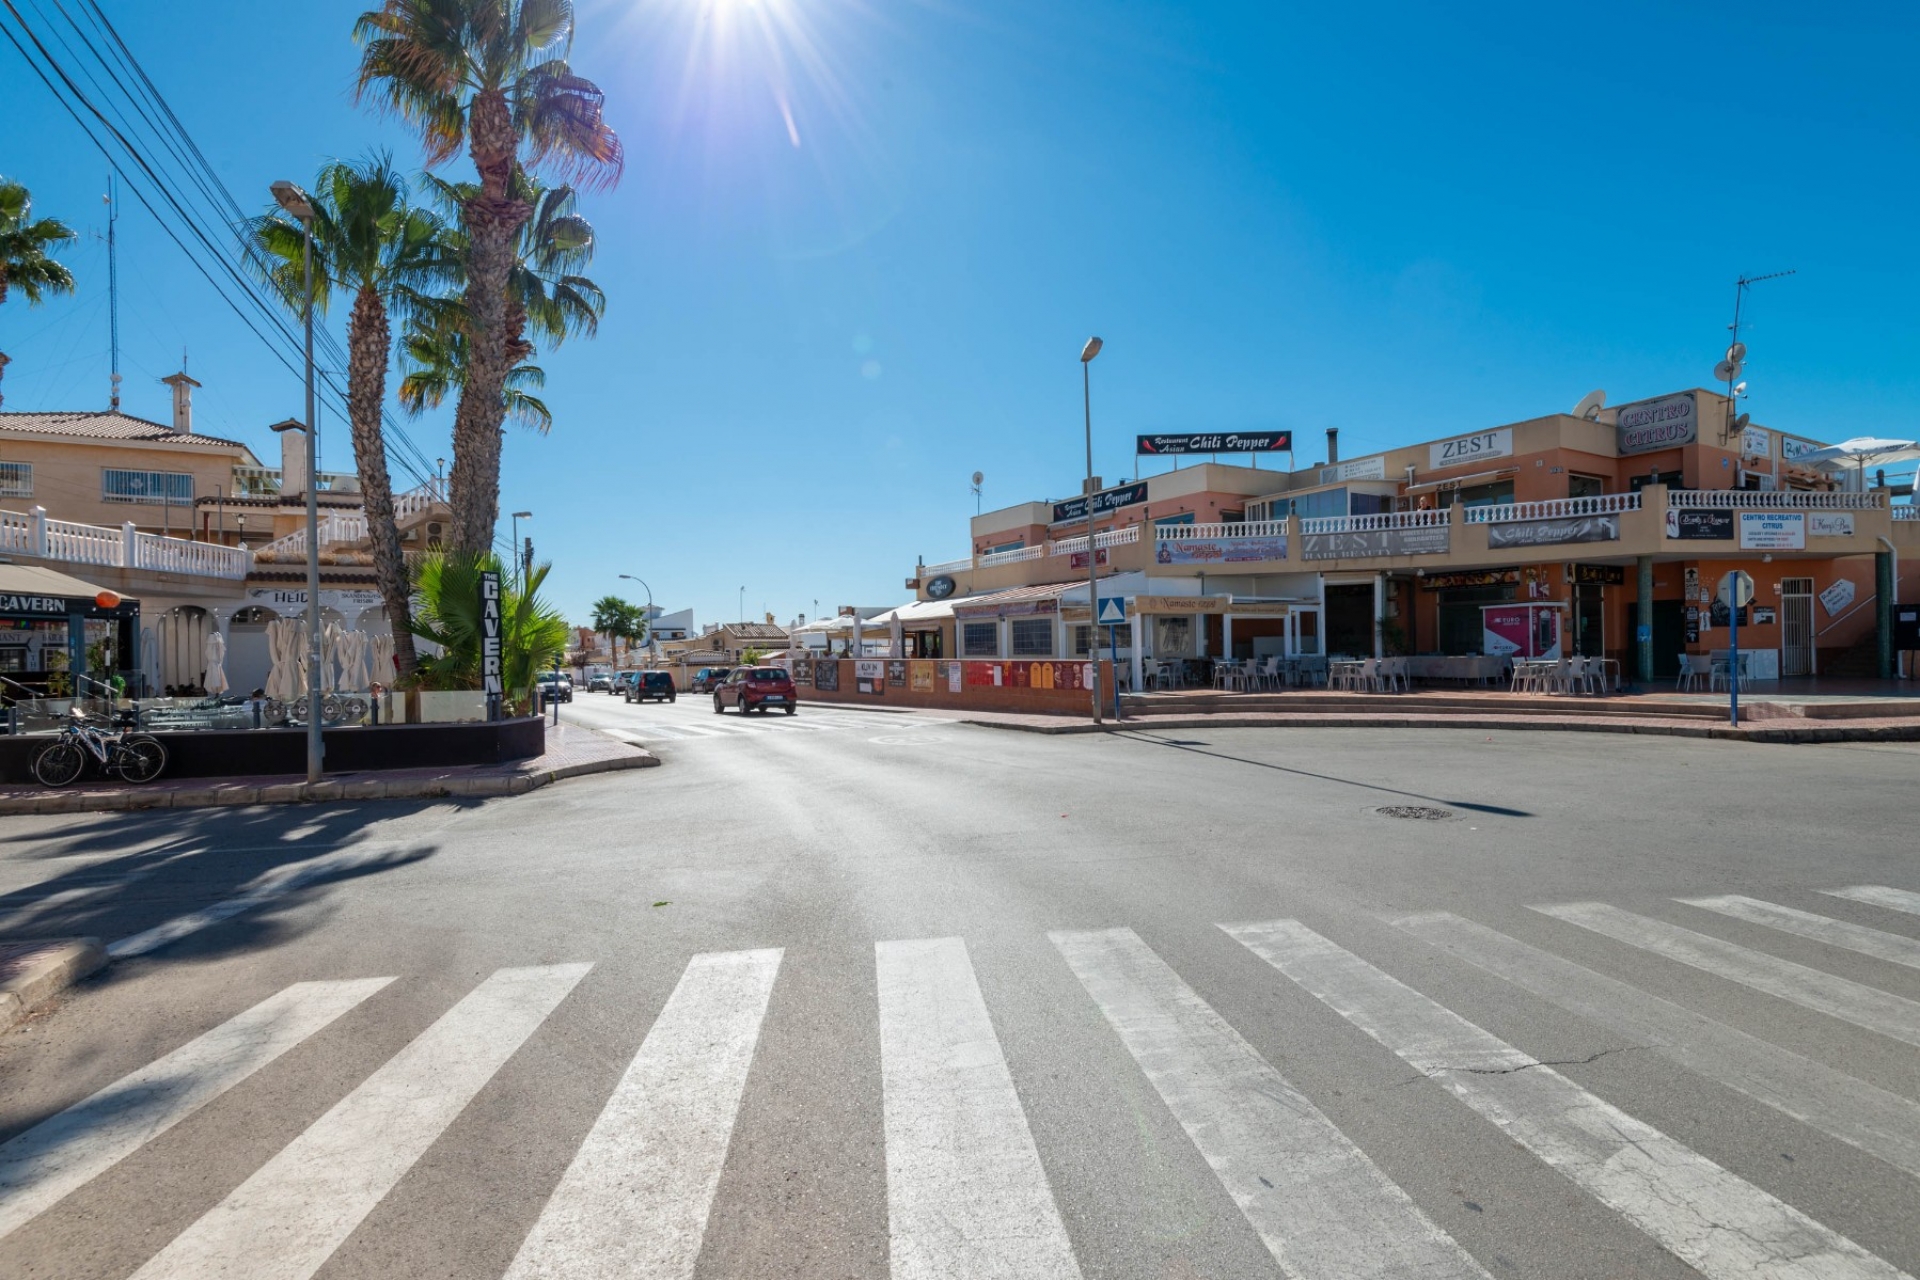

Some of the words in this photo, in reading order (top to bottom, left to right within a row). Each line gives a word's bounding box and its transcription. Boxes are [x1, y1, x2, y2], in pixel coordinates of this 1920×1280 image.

[1622, 401, 1690, 428] CENTRO
[1624, 422, 1688, 447] CITRUS
[1159, 445, 1185, 453] Asian
[1190, 436, 1222, 449] Chili
[1226, 434, 1270, 450] Pepper
[1442, 433, 1497, 459] ZEST
[1436, 480, 1463, 492] ZEST
[1105, 492, 1132, 506] Pepper
[1767, 513, 1802, 521] RECREATIVO
[1505, 526, 1533, 539] Chili
[1537, 524, 1578, 539] Pepper
[1762, 522, 1783, 530] CITRUS
[1172, 542, 1217, 554] Namaste
[1304, 531, 1394, 552] ZEST
[1341, 549, 1392, 558] BEAUTY
[0, 595, 65, 612] CAVERN
[1160, 598, 1195, 607] Namaste
[484, 581, 502, 694] CAVERN
